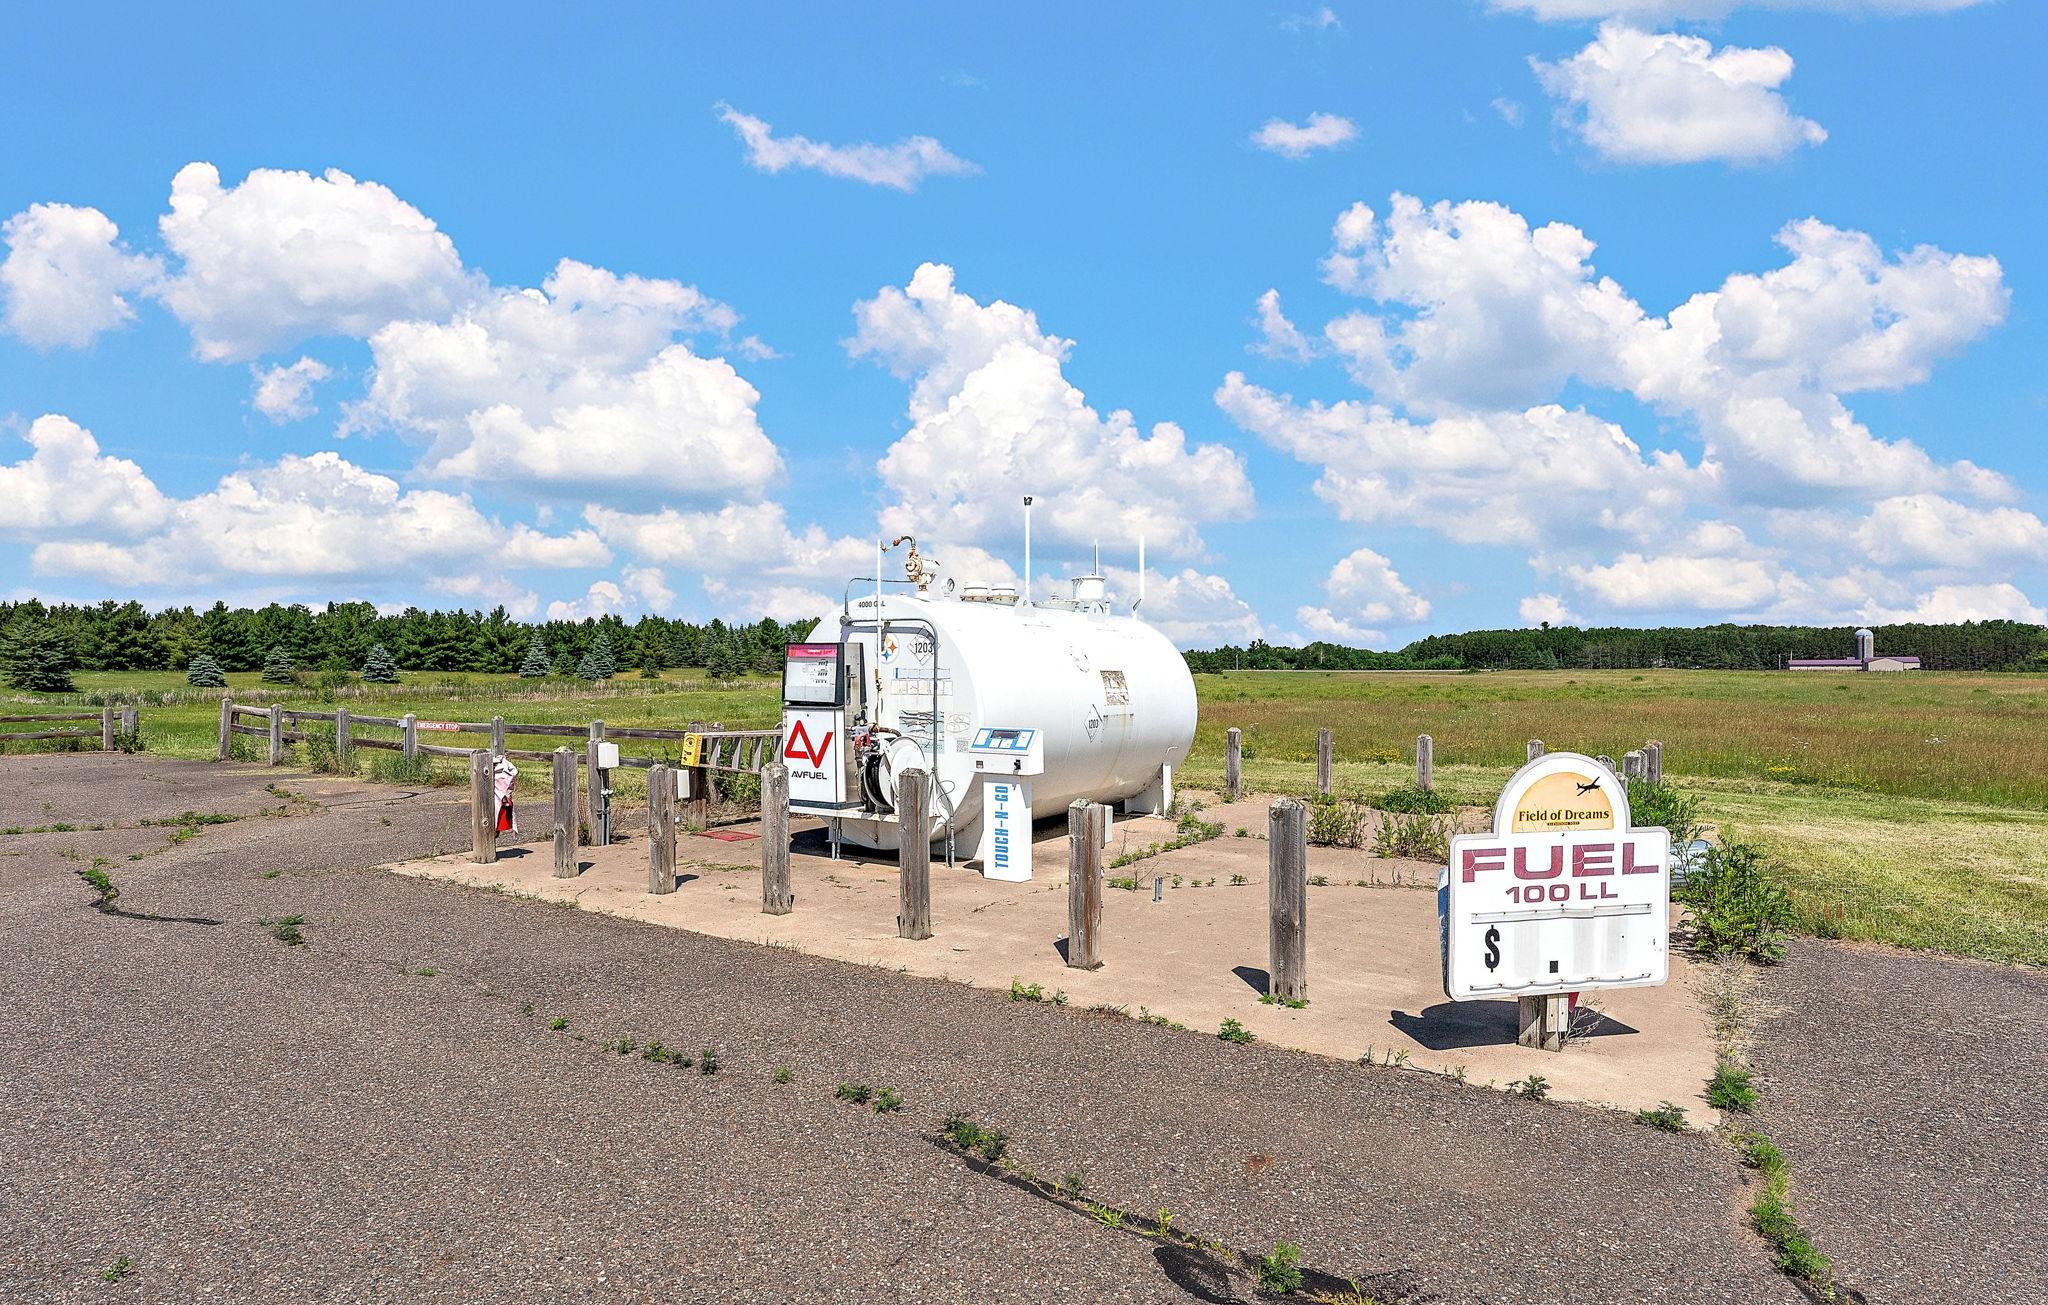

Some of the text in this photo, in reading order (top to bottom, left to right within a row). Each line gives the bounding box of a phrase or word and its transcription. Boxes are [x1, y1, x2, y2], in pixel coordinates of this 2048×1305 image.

[915, 642, 933, 653] 1203
[445, 723, 459, 731] STOP
[1088, 719, 1099, 729] 1203
[791, 770, 827, 780] AVFUEL
[1519, 809, 1609, 822] Field of Dreams
[995, 785, 1009, 868] TOUCH-N-GO
[1462, 843, 1659, 882] FUEL
[1506, 882, 1618, 903] 100 LL
